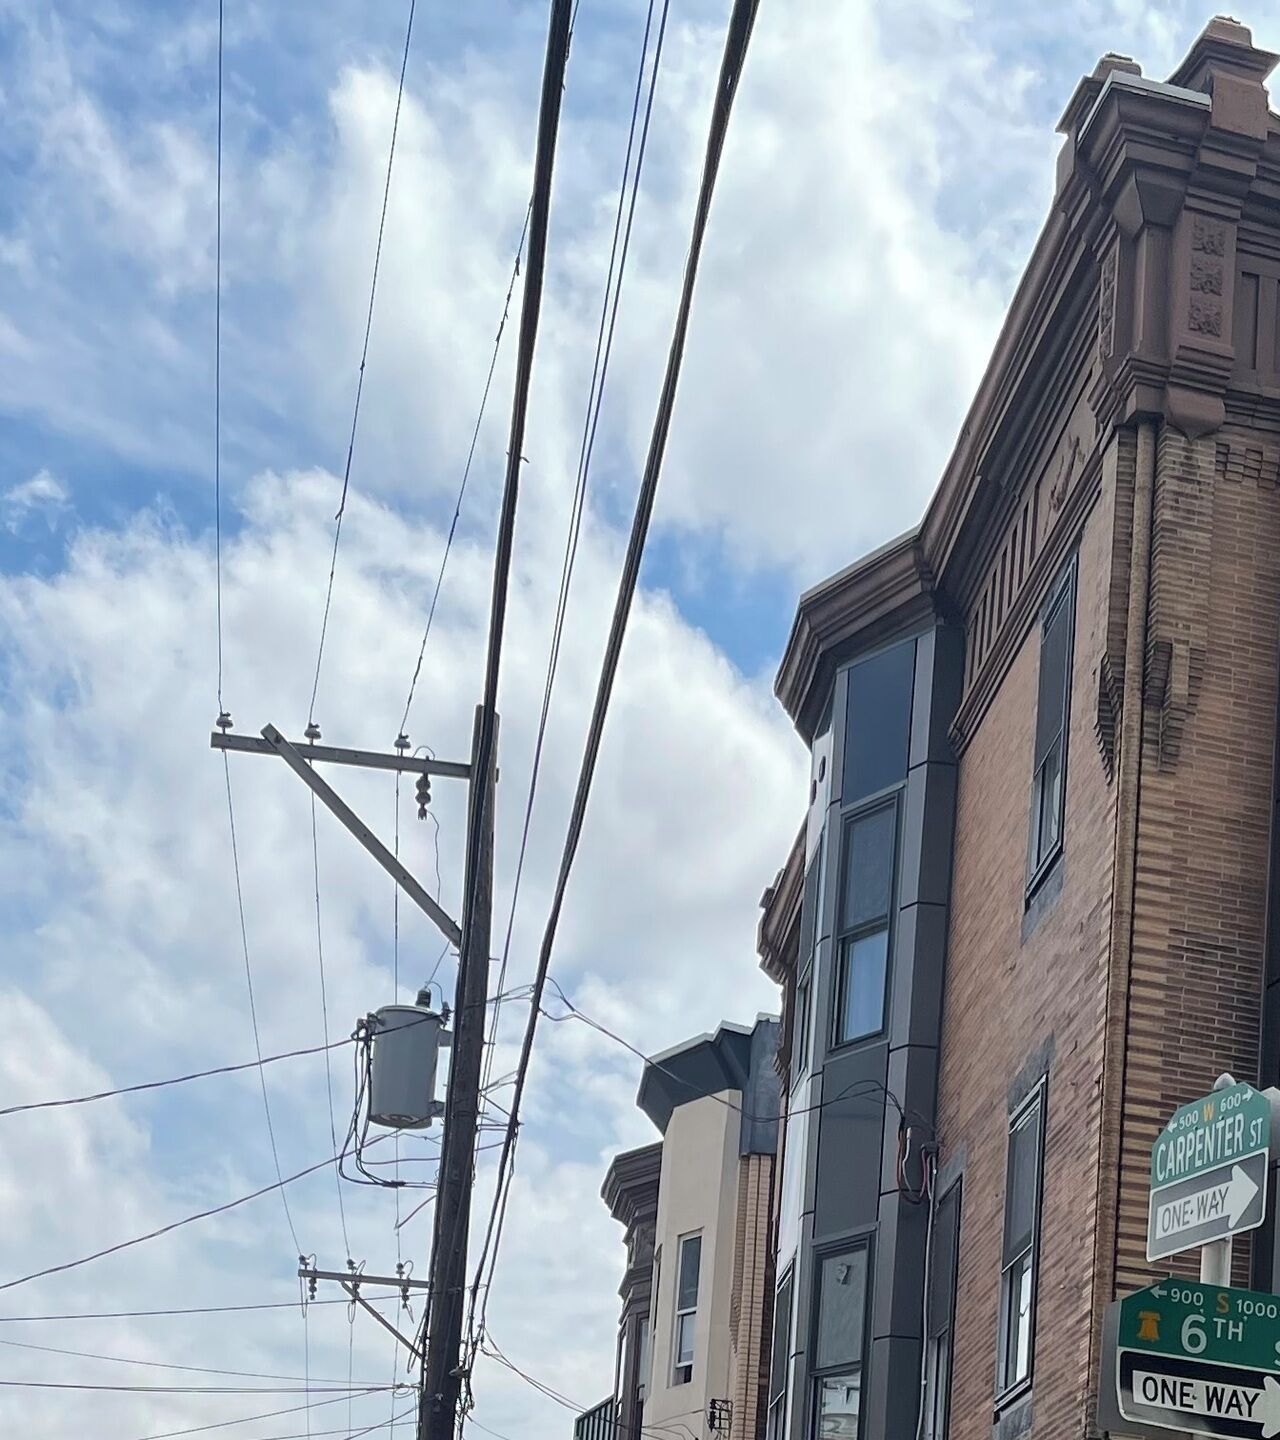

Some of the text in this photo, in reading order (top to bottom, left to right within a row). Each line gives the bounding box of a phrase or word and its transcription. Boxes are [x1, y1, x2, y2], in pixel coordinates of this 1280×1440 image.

[1178, 1092, 1242, 1130] 500 W 600
[1155, 1112, 1263, 1183] CARPENTER ST
[1161, 1186, 1231, 1233] ONE WAY
[1170, 1288, 1278, 1320] 900 S 1000
[1180, 1313, 1244, 1354] 6TH
[1141, 1375, 1261, 1419] ONE WAY
